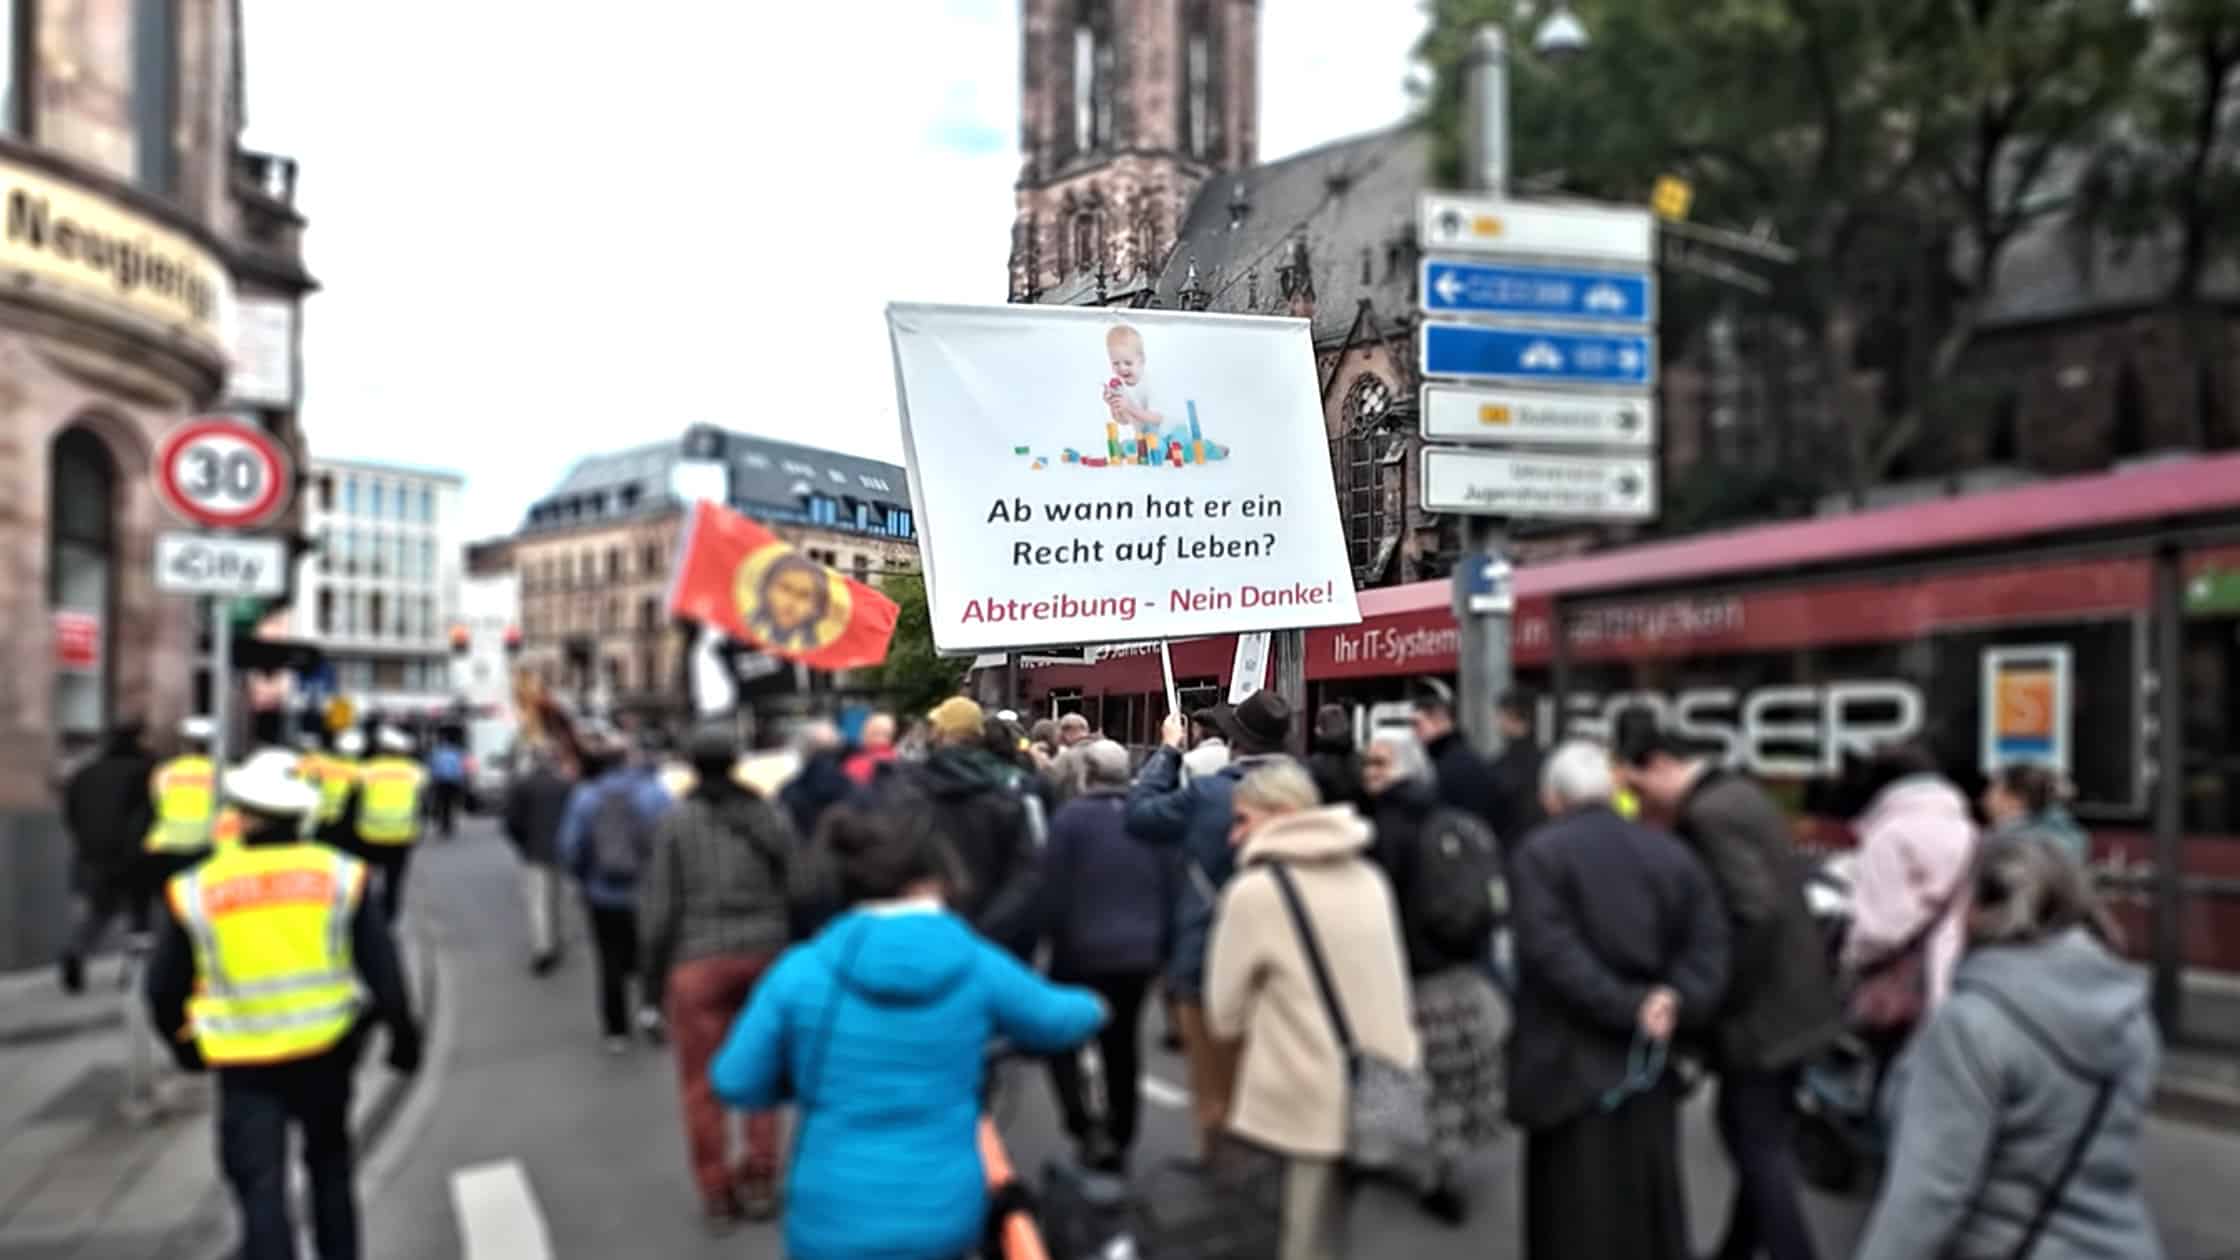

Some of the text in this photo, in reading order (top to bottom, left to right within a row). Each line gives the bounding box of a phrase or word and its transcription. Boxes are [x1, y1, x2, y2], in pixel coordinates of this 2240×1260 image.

[184, 446, 262, 500] 30
[986, 493, 1282, 524] Ab wann hat er ein
[1012, 532, 1276, 567] Recht auf Leben?
[961, 594, 1137, 624] Abtreibung
[1170, 586, 1233, 613] Nein
[1240, 580, 1333, 608] Danke!
[1334, 632, 1362, 663] Ihr
